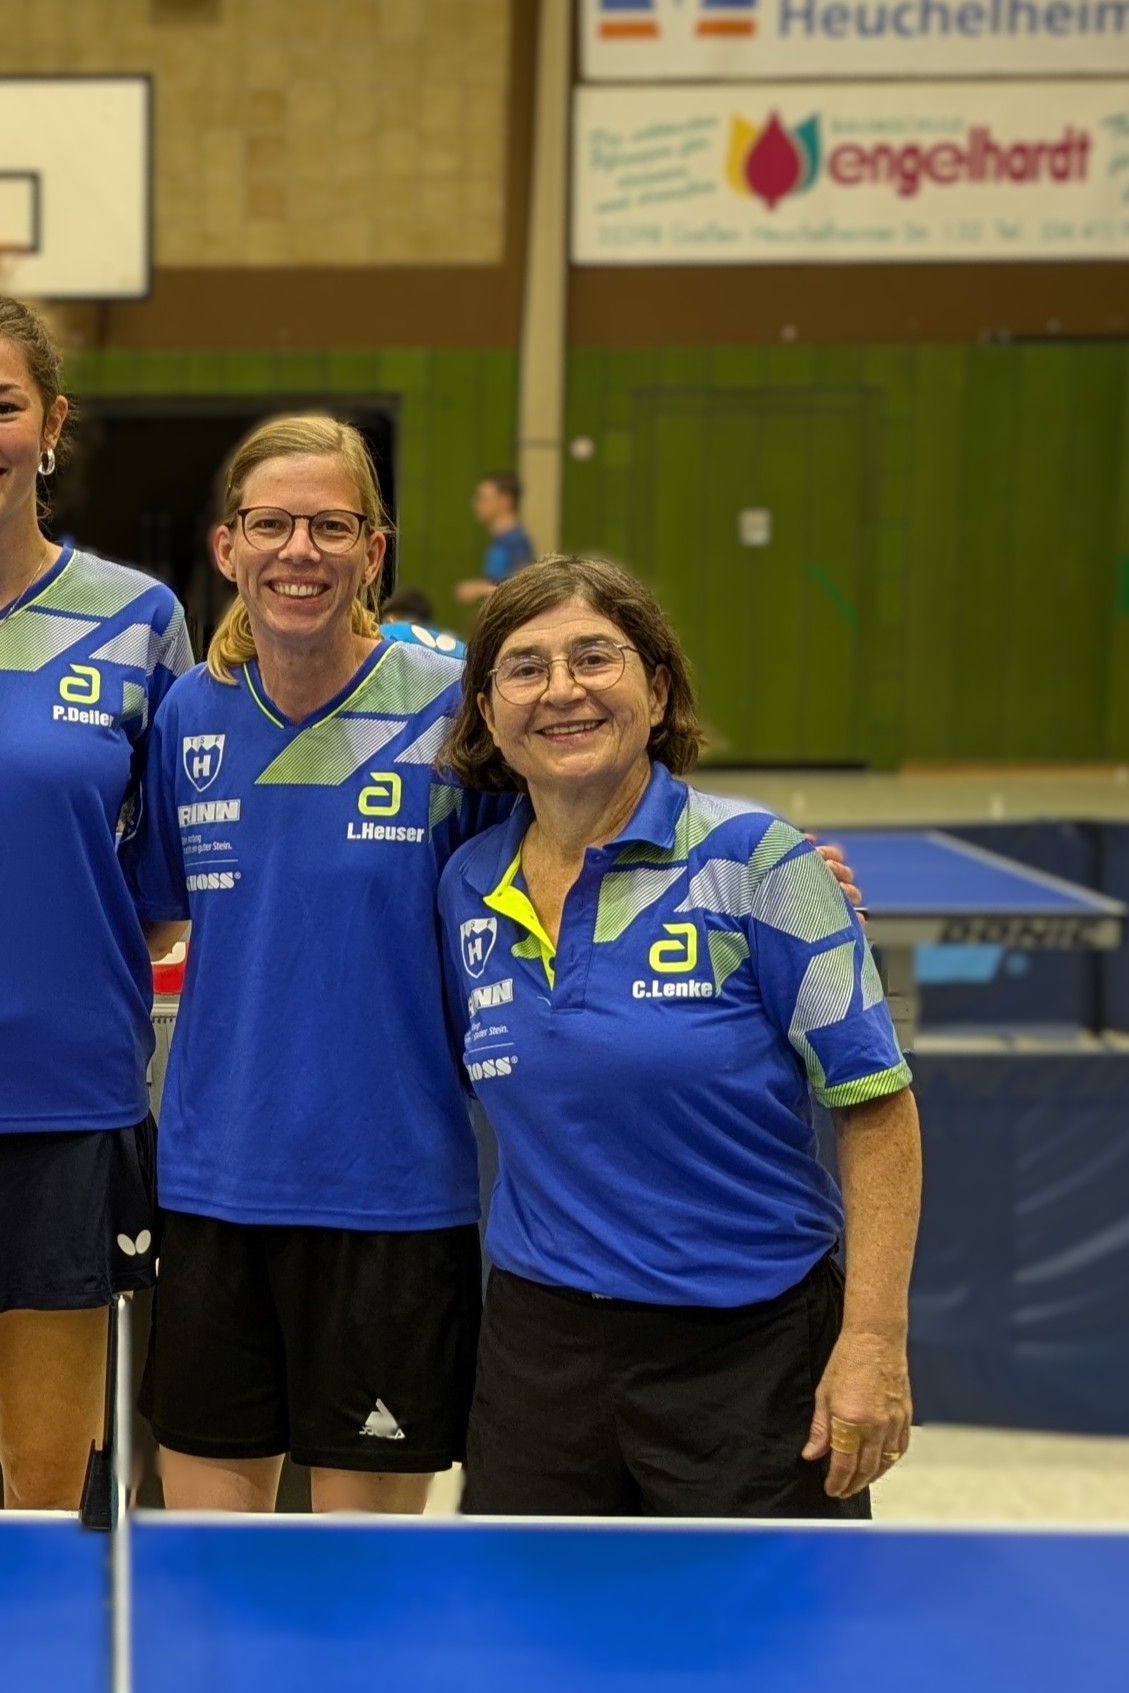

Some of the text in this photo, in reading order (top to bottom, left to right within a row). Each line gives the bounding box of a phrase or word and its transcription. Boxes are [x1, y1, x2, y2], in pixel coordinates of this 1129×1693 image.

[828, 124, 1090, 198] engelhardt
[179, 801, 239, 827] RINN
[347, 822, 425, 843] L.Heuser
[632, 979, 713, 999] C.Lenke
